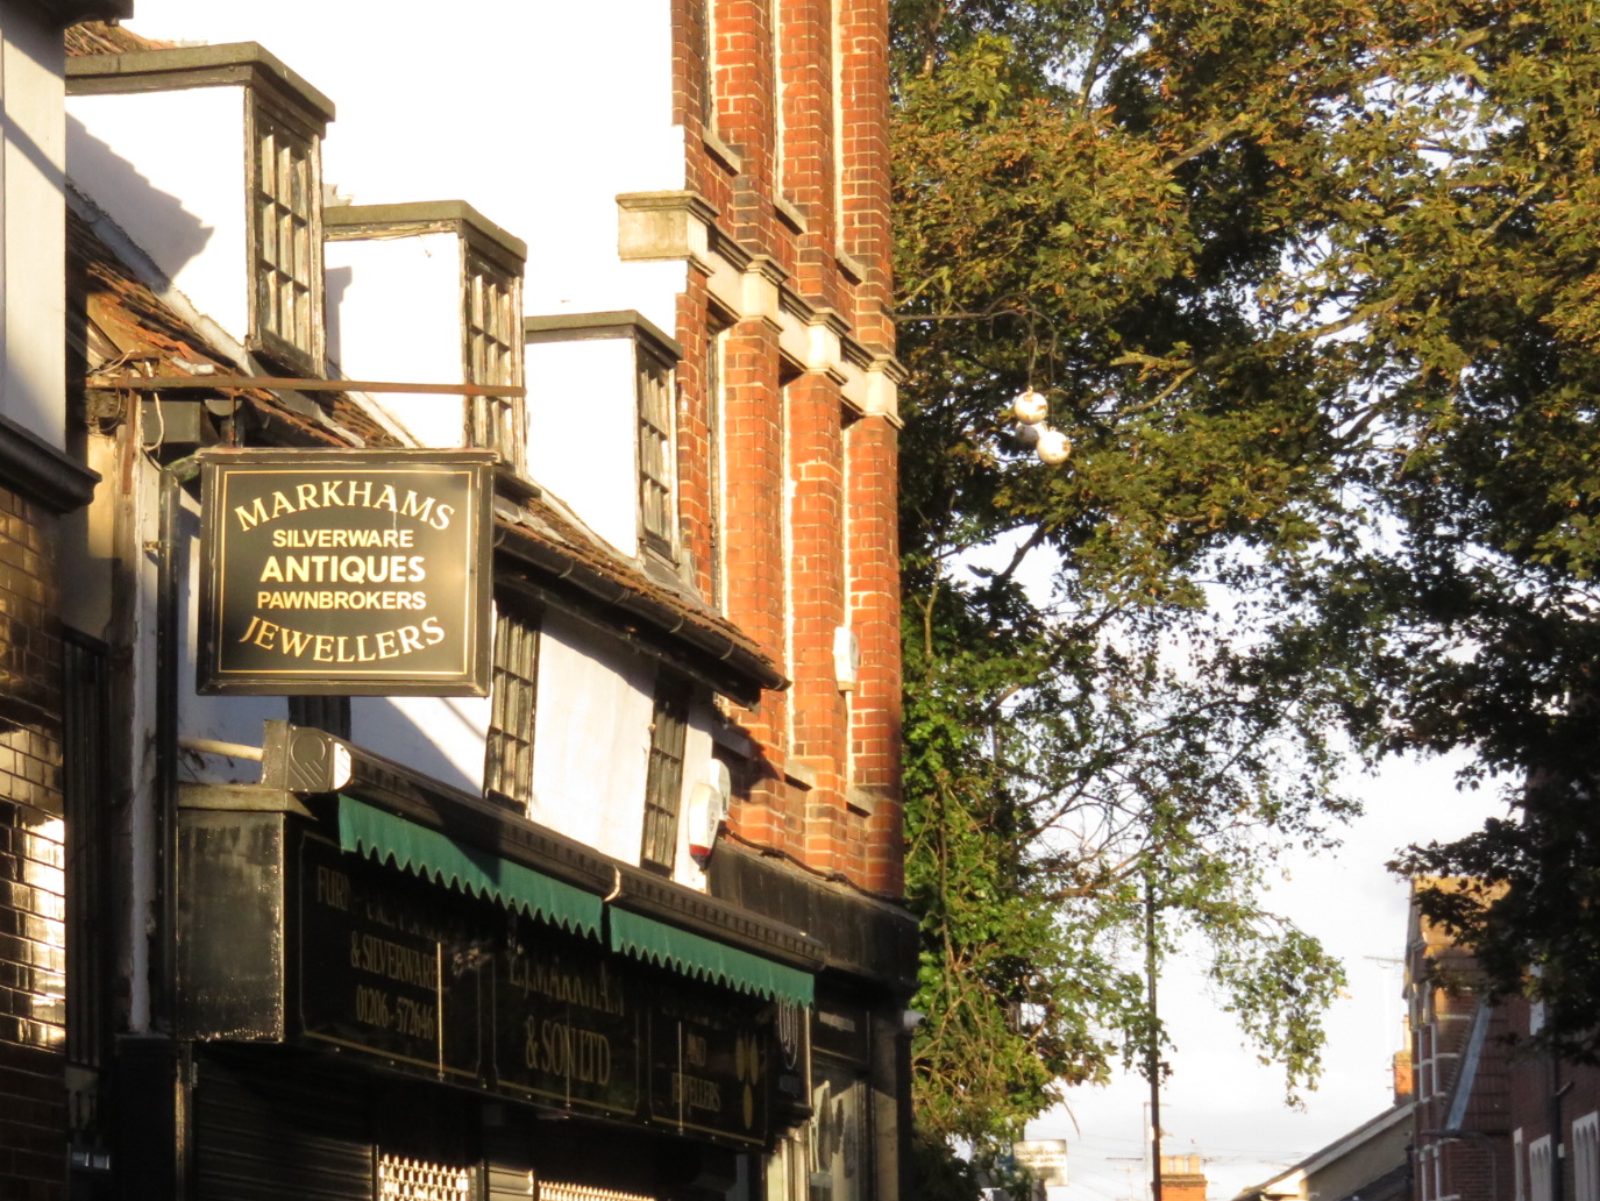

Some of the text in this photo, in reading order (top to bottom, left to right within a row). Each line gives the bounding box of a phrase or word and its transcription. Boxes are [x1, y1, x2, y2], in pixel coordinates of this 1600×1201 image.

[234, 480, 455, 532] MARKHAMS
[272, 529, 414, 548] SILVERWARE
[259, 555, 426, 584] ANTIQUES
[257, 591, 427, 610] PAWNBROKERS
[238, 616, 446, 663] JEWELLERS
[362, 931, 442, 992] SILVERWARE
[524, 1013, 539, 1070] &
[541, 1019, 576, 1080] SON
